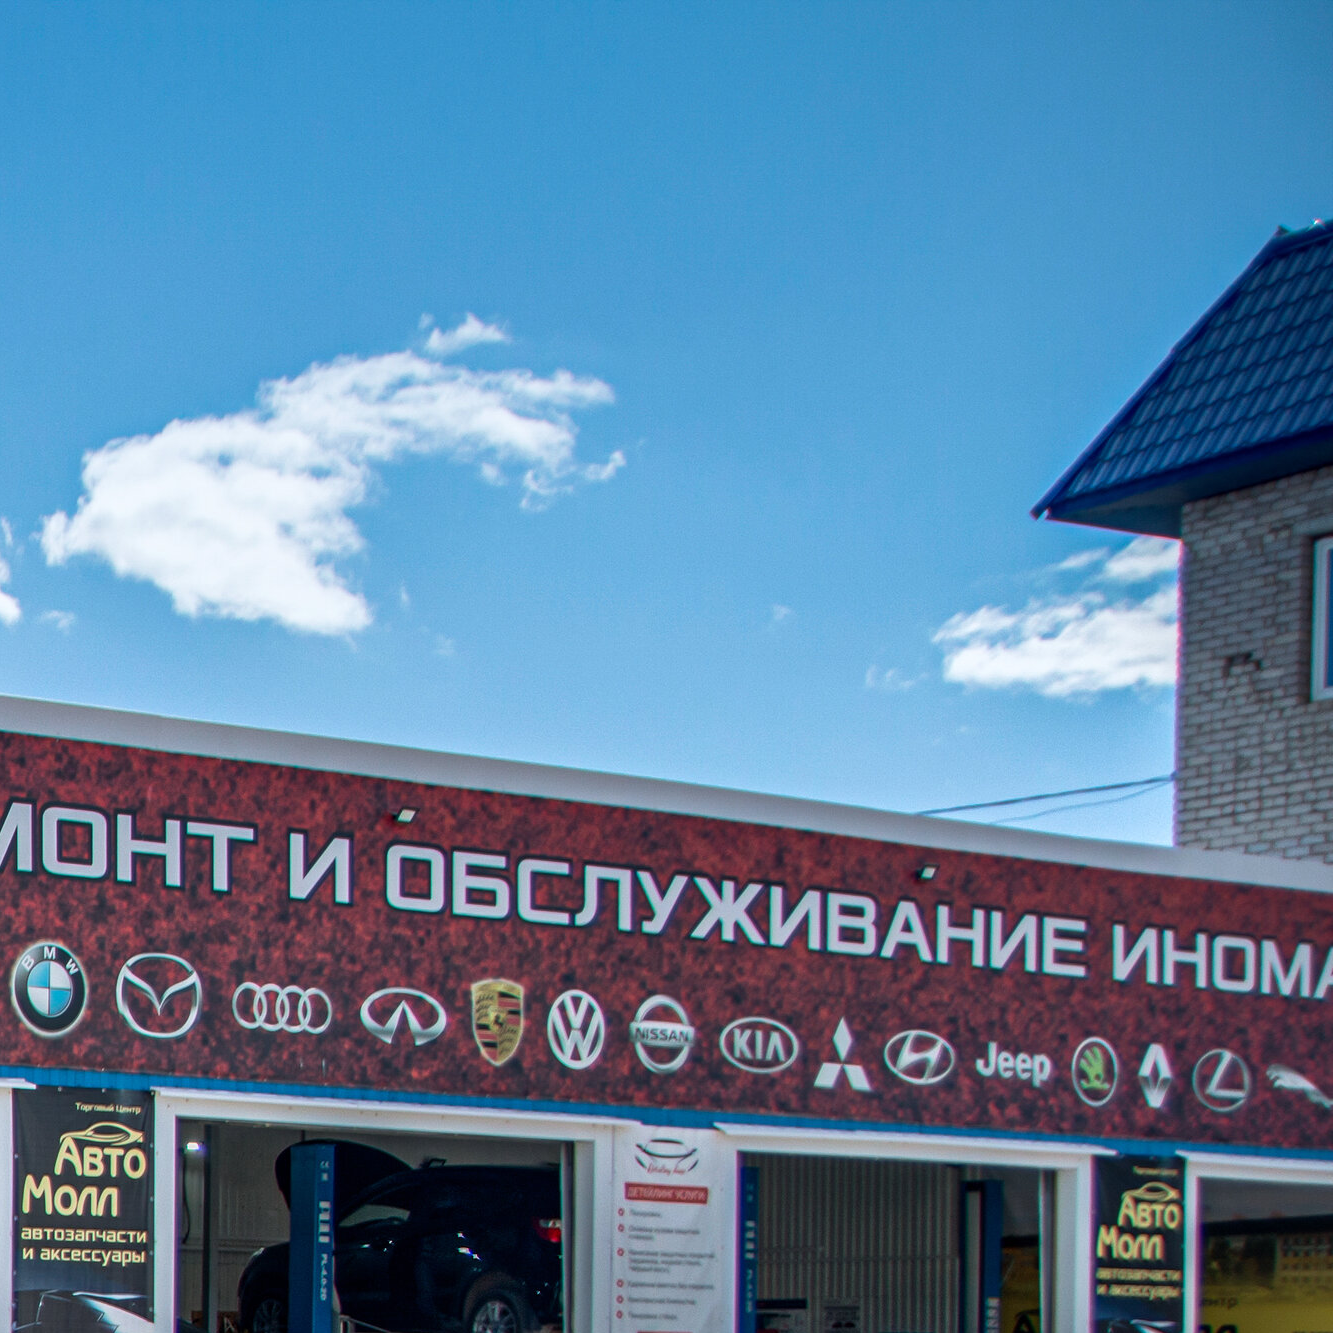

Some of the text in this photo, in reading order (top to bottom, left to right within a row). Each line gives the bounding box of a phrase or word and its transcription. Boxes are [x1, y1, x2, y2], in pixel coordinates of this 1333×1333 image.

[289, 833, 351, 905] И
[386, 844, 1087, 978] ОБСЛУЖИВАНИЕ
[636, 1027, 690, 1043] NISSAN
[734, 1029, 786, 1062] KIA
[976, 1042, 1050, 1087] Jeep
[75, 1102, 142, 1115] Торговый Центр
[54, 1136, 147, 1180] Авто
[22, 1174, 118, 1218] Молл
[1117, 1194, 1182, 1230] Авто
[21, 1227, 148, 1244] автозапчасти
[1097, 1224, 1164, 1260] Молл
[22, 1247, 145, 1267] и аксессуары
